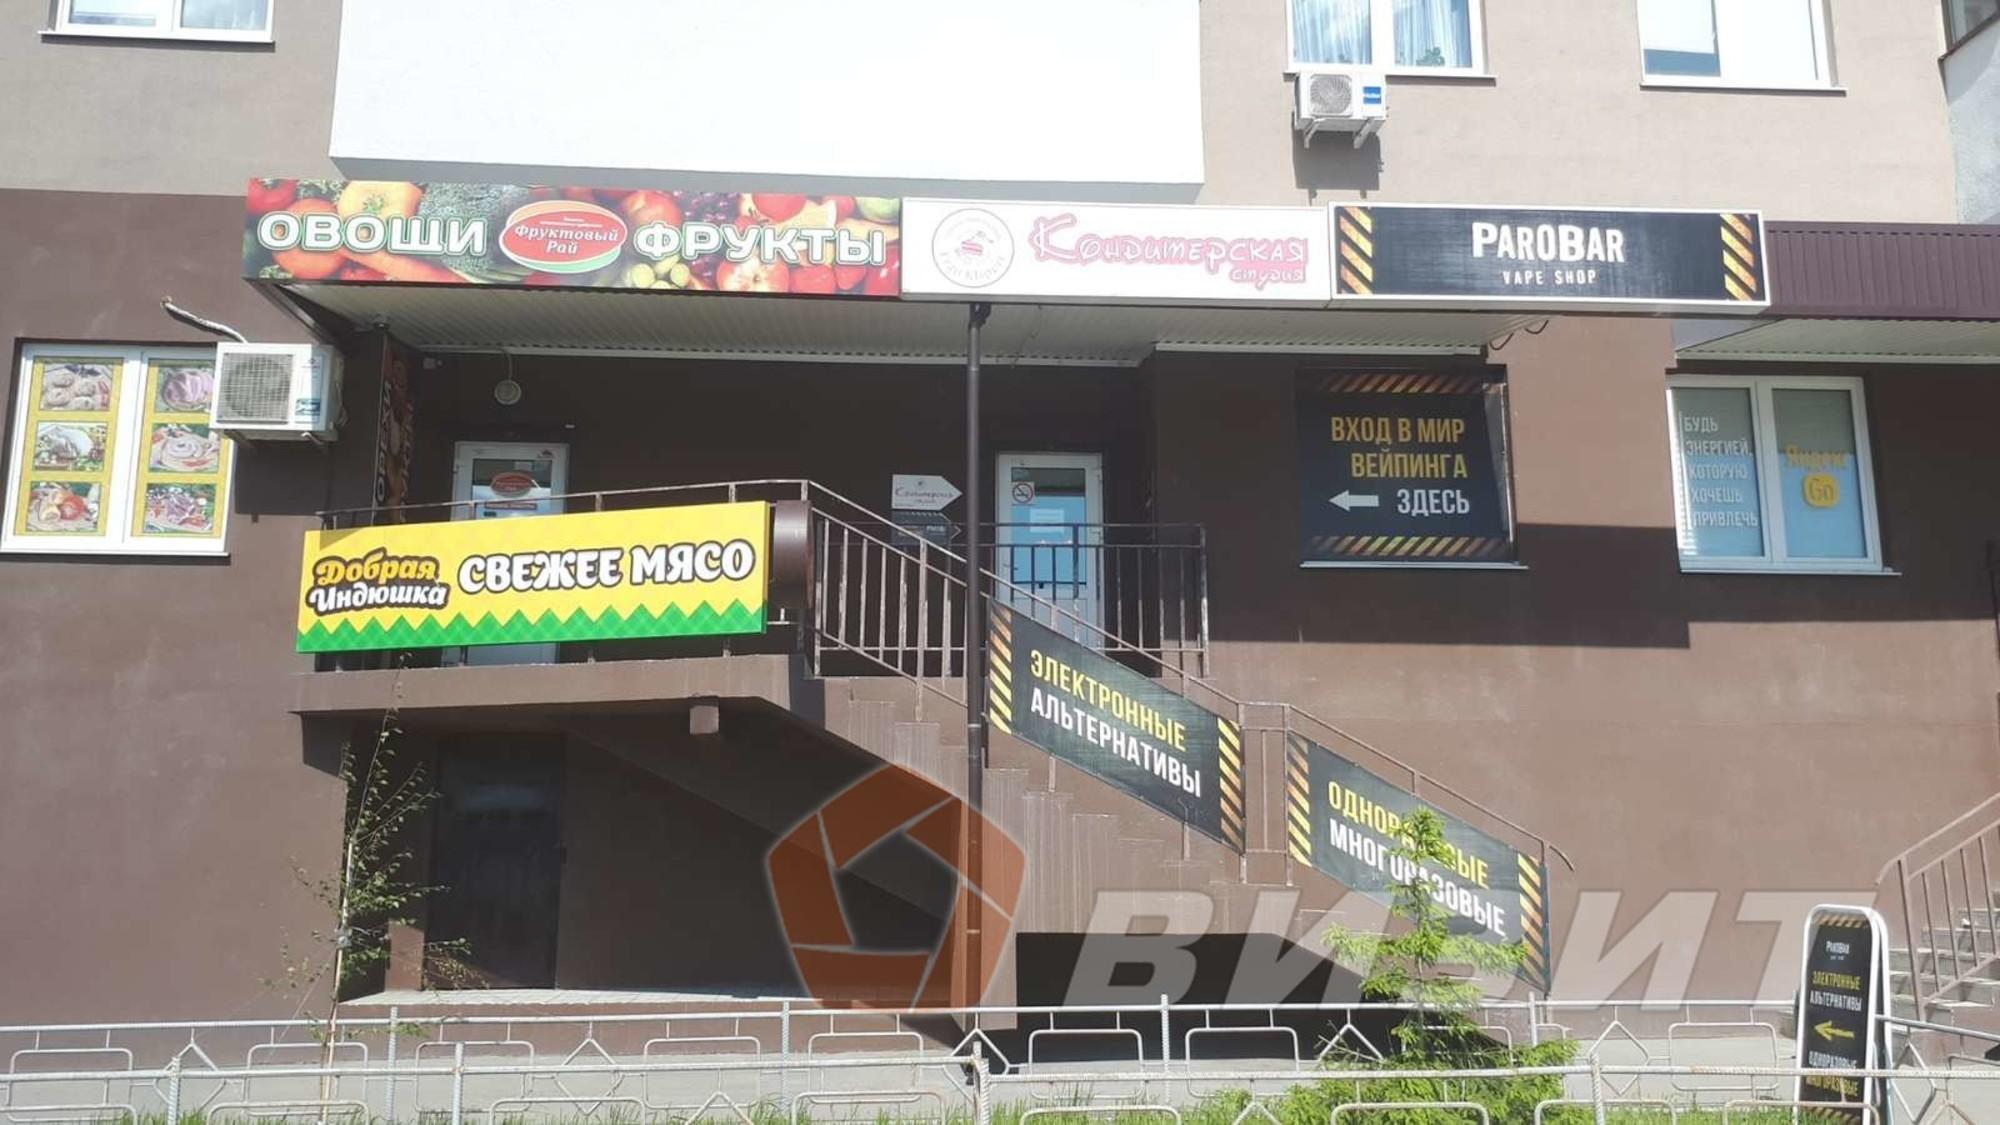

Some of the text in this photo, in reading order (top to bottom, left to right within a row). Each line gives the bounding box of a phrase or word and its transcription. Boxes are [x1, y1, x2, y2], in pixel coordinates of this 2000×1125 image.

[258, 212, 488, 256] ОВОЩИ
[515, 224, 619, 241] Фруктовый
[635, 222, 885, 265] ФРУКТЫ
[546, 240, 578, 254] Рай
[1503, 270, 1596, 285] VAPE SHOP
[1331, 416, 1465, 444] ВХОД В МИР
[1684, 416, 1718, 433] БУДЬ
[1351, 448, 1468, 478] ВЕЙПИНГА
[1689, 464, 1748, 480] КОТОРУЮ
[1397, 488, 1470, 516] ЗДЕСЬ
[1692, 488, 1743, 503] ХОЧЕШЬ
[1693, 511, 1759, 527] ПРИВЛЕЧЬ
[313, 548, 439, 585] Добрая
[459, 540, 755, 593] СВЕЖЕЕ МЯСО
[307, 581, 449, 615] Индюшка
[1030, 650, 1186, 751] ЭЛЕКТРОННЫЕ
[1031, 687, 1201, 798] АЛЬТЕРНАТИВЫ
[1809, 990, 1862, 1011] АЛЬТЕРНАТИВЫ
